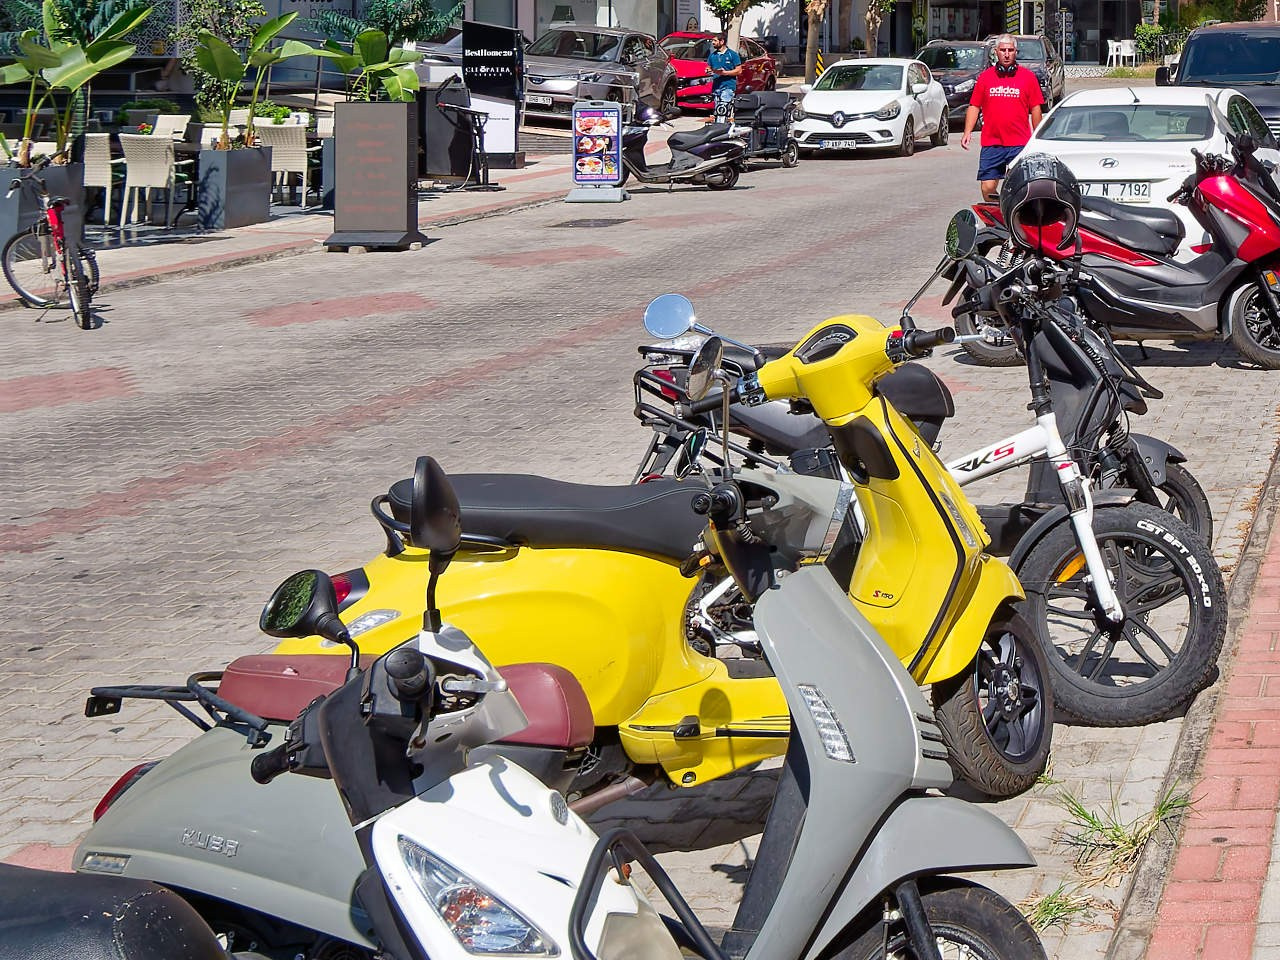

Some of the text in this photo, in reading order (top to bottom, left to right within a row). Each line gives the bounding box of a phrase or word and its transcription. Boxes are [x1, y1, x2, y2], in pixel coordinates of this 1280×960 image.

[989, 86, 1020, 95] adidas
[1102, 183, 1109, 197] N
[1120, 183, 1148, 197] 7192
[951, 442, 1015, 472] RKS
[1136, 520, 1165, 535] CST
[182, 827, 239, 857] KUBA
